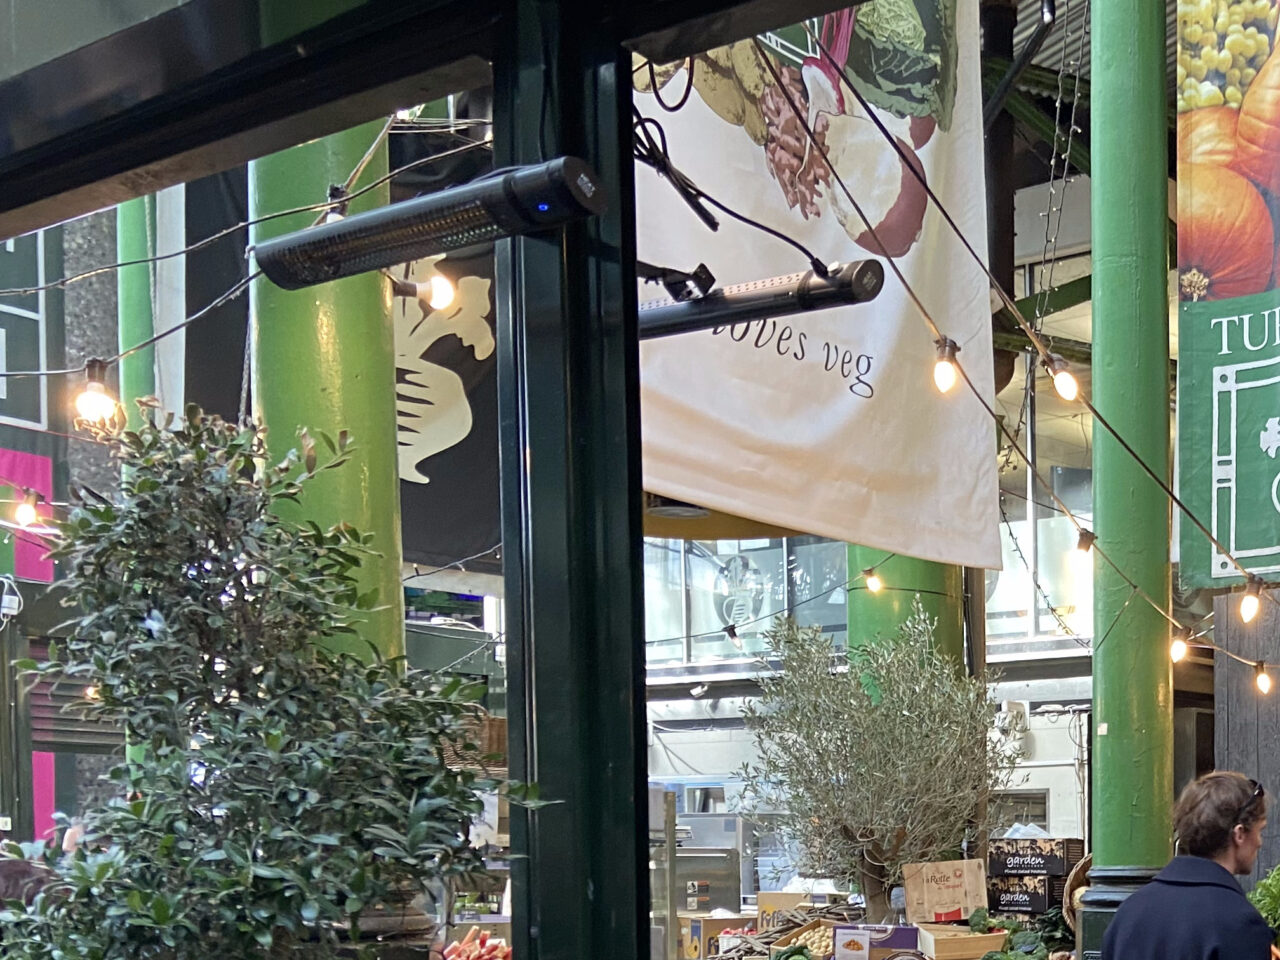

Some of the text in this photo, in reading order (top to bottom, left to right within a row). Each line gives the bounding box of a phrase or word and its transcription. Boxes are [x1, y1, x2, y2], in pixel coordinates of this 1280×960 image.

[712, 319, 874, 399] oves veg
[1006, 855, 1045, 868] garden
[1000, 892, 1030, 904] garden
